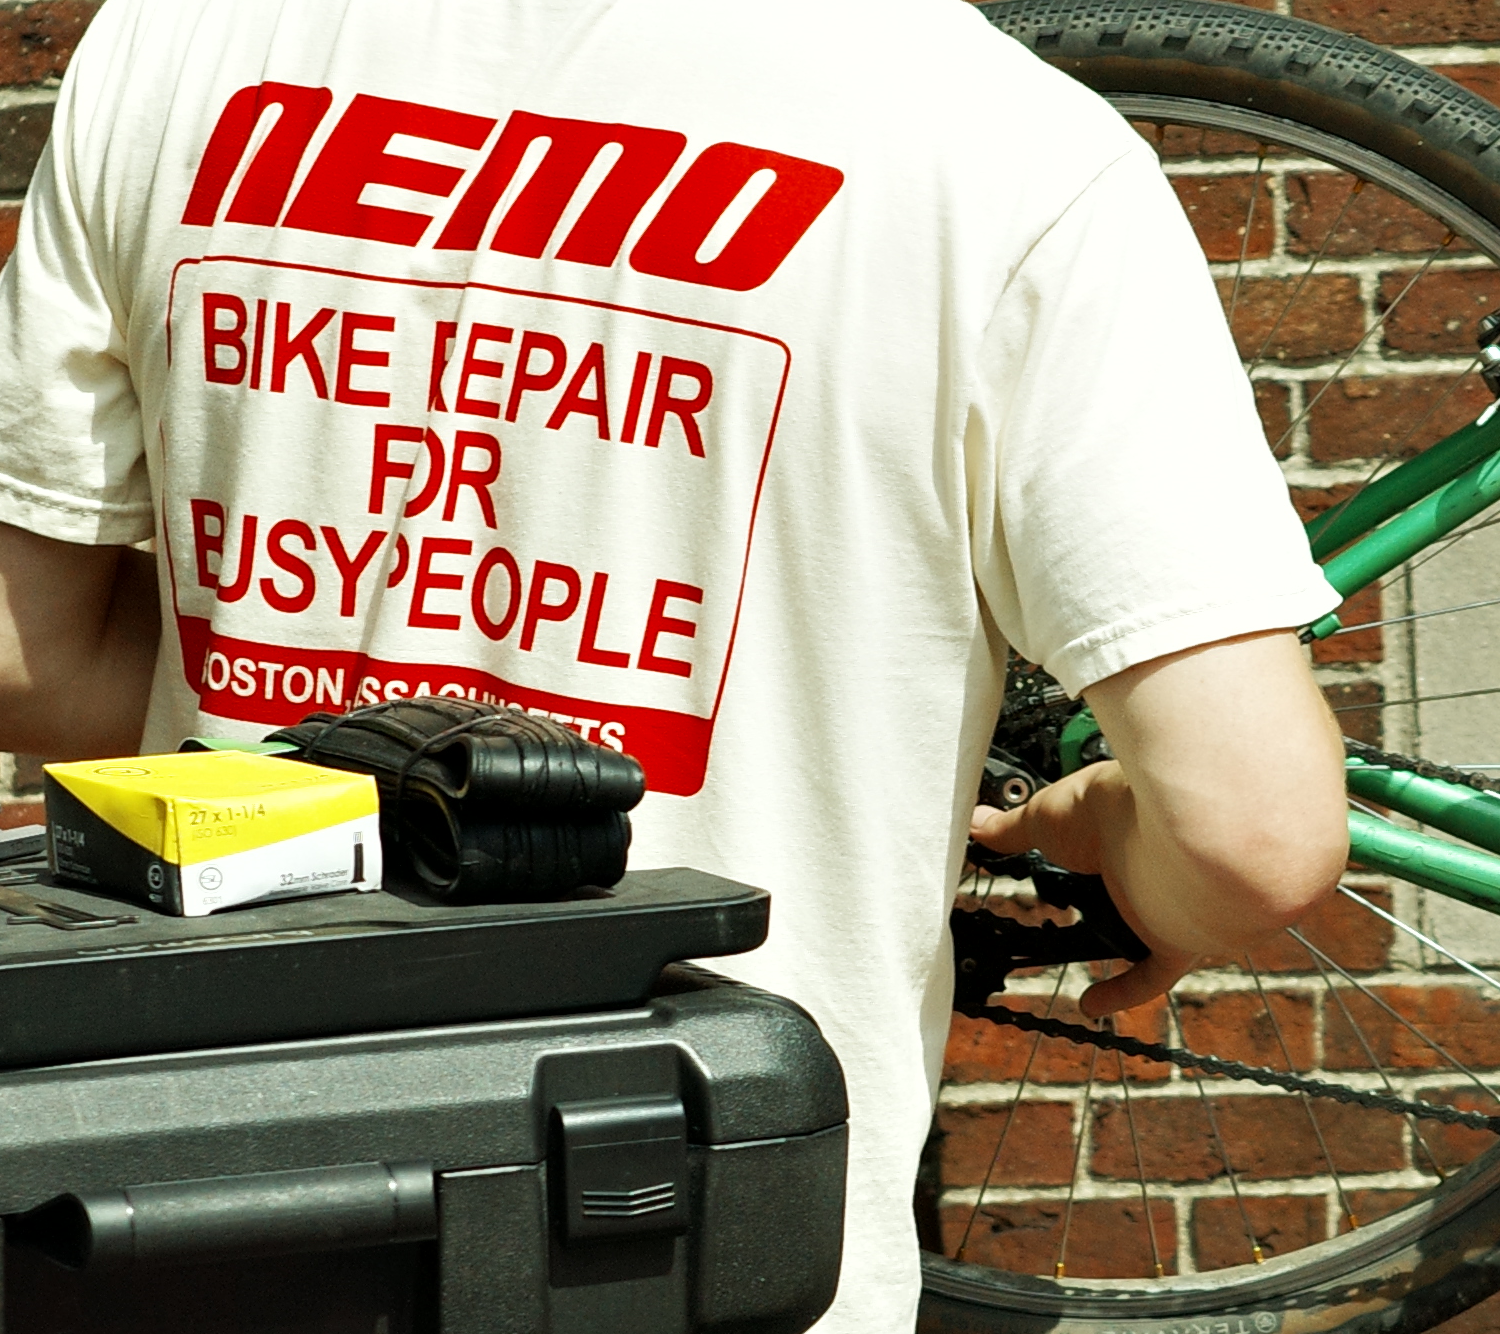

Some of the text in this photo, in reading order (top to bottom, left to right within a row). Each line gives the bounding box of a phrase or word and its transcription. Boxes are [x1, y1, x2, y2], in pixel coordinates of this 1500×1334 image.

[181, 81, 844, 291] NEMO
[203, 292, 395, 407] BIKE
[368, 423, 502, 530] FOR
[190, 500, 388, 616] BUSY
[202, 647, 351, 712] OSTON,
[190, 803, 267, 826] 27 x 1-1/4
